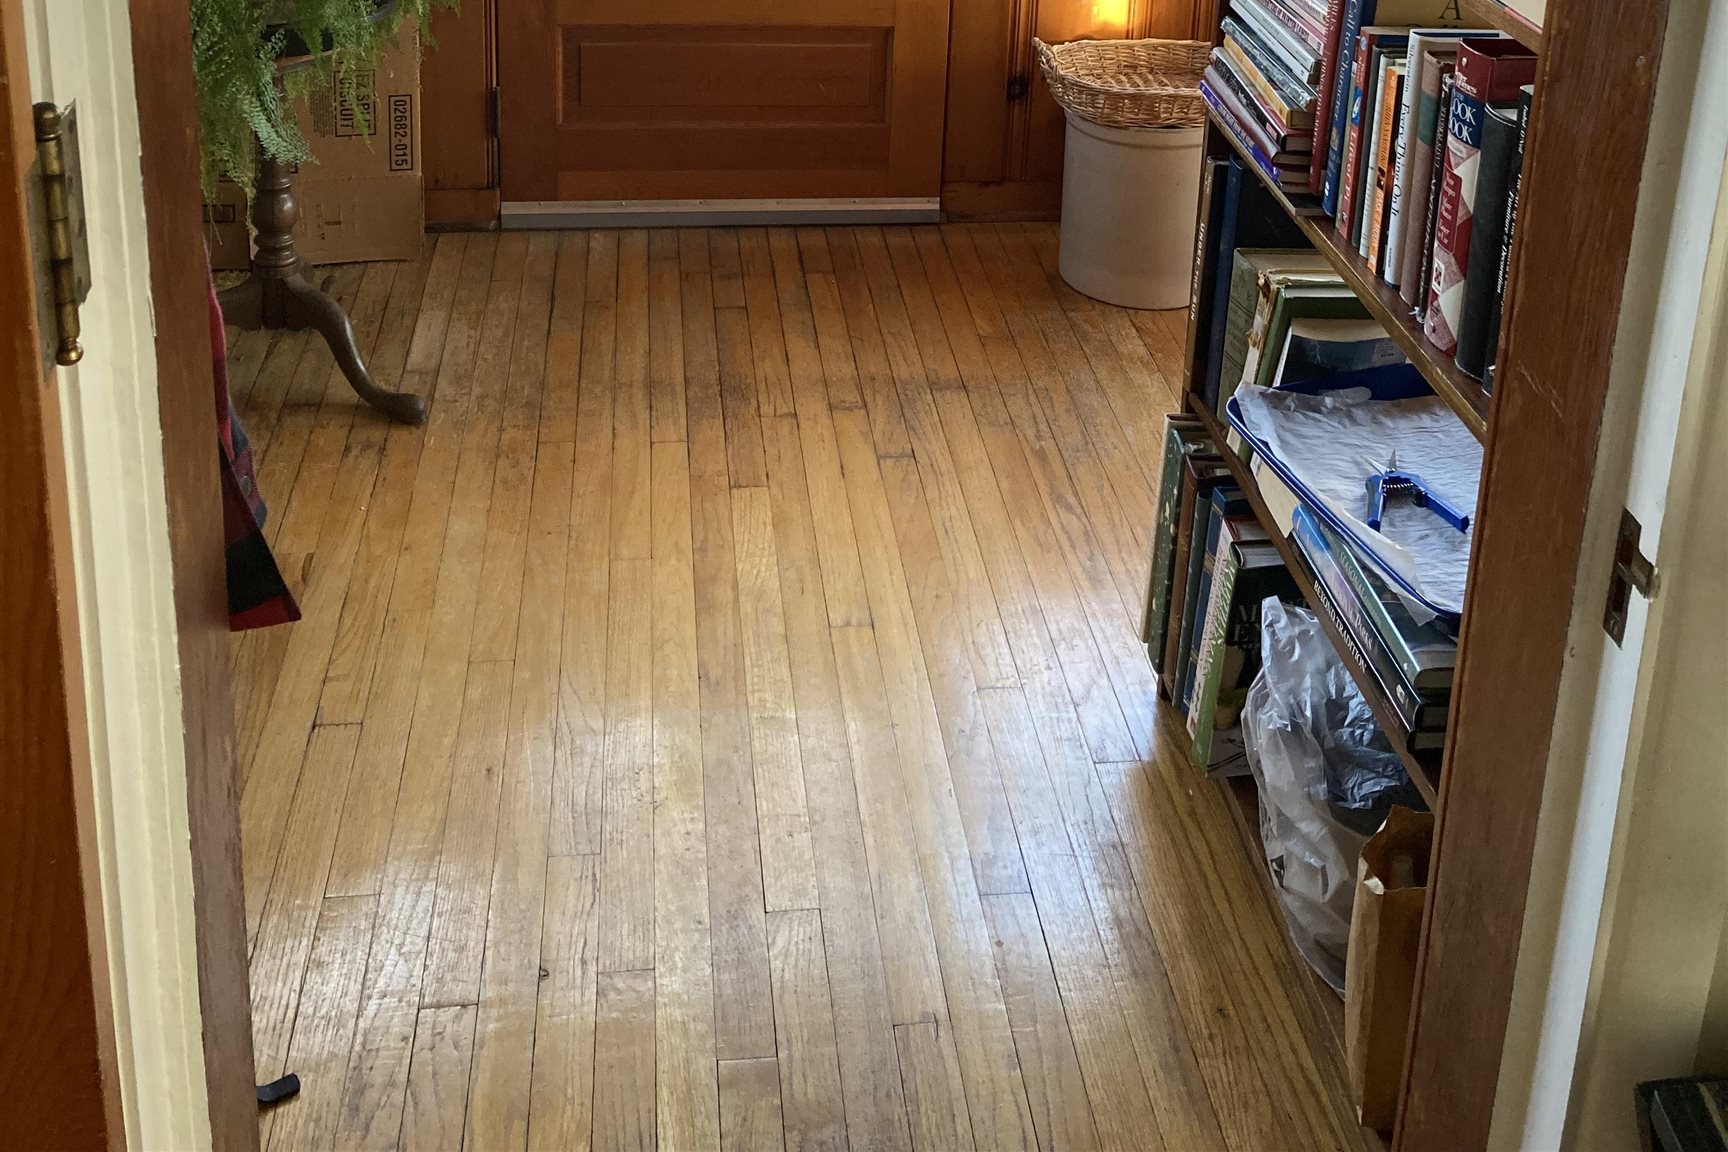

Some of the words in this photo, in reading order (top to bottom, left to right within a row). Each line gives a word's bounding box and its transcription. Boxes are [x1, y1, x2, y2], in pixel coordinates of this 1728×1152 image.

[1348, 0, 1358, 29] Call
[1344, 33, 1351, 46] to
[1334, 50, 1350, 121] Character
[1405, 45, 1415, 93] Silverstein
[393, 99, 408, 167] 02682-015
[1399, 103, 1410, 141] Every
[1348, 131, 1356, 161] Life
[1394, 142, 1407, 182] Thing
[1346, 163, 1353, 180] of
[1344, 184, 1350, 200] Pi
[1392, 184, 1402, 204] On
[1391, 207, 1399, 217] It
[1505, 191, 1514, 234] Furniture
[1196, 223, 1205, 266] UNDER
[1497, 245, 1508, 294] Decoration
[1190, 296, 1198, 321] SUN
[1314, 580, 1337, 622] BEYOND
[1335, 614, 1367, 673] TRADITION
